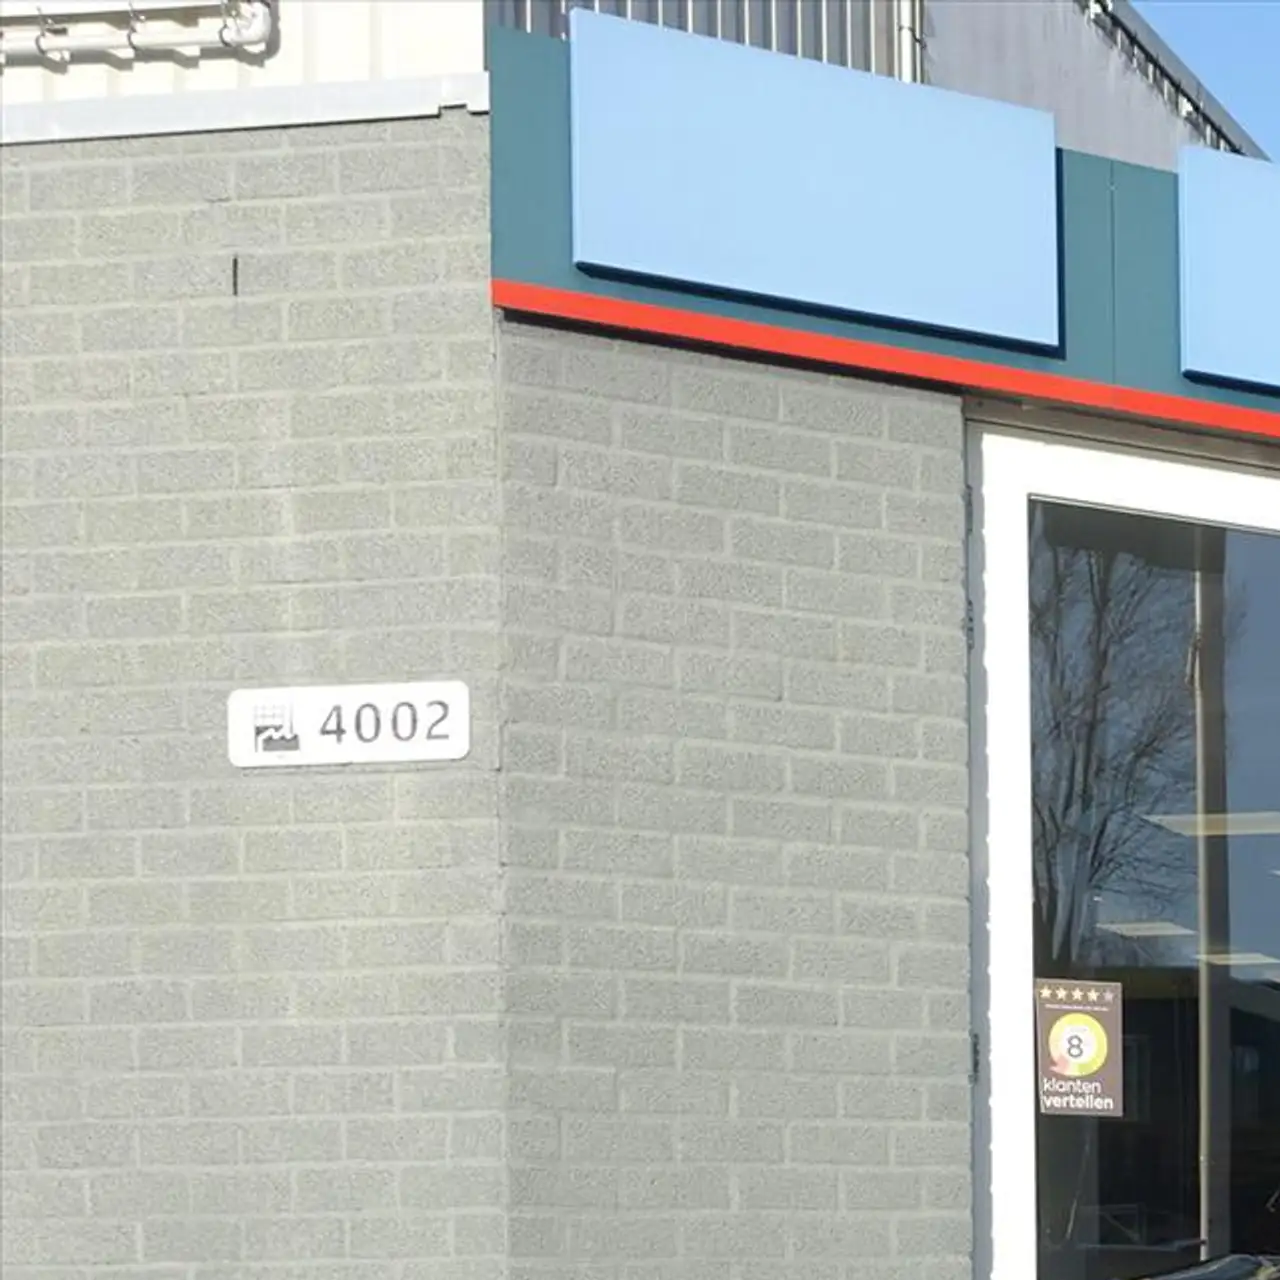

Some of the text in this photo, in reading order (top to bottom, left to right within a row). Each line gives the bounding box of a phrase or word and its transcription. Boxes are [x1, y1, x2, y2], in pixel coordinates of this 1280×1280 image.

[320, 700, 450, 744] 4002
[1067, 1035, 1083, 1058] 8
[1043, 1078, 1102, 1094] klanten
[1042, 1095, 1114, 1110] vertellen
